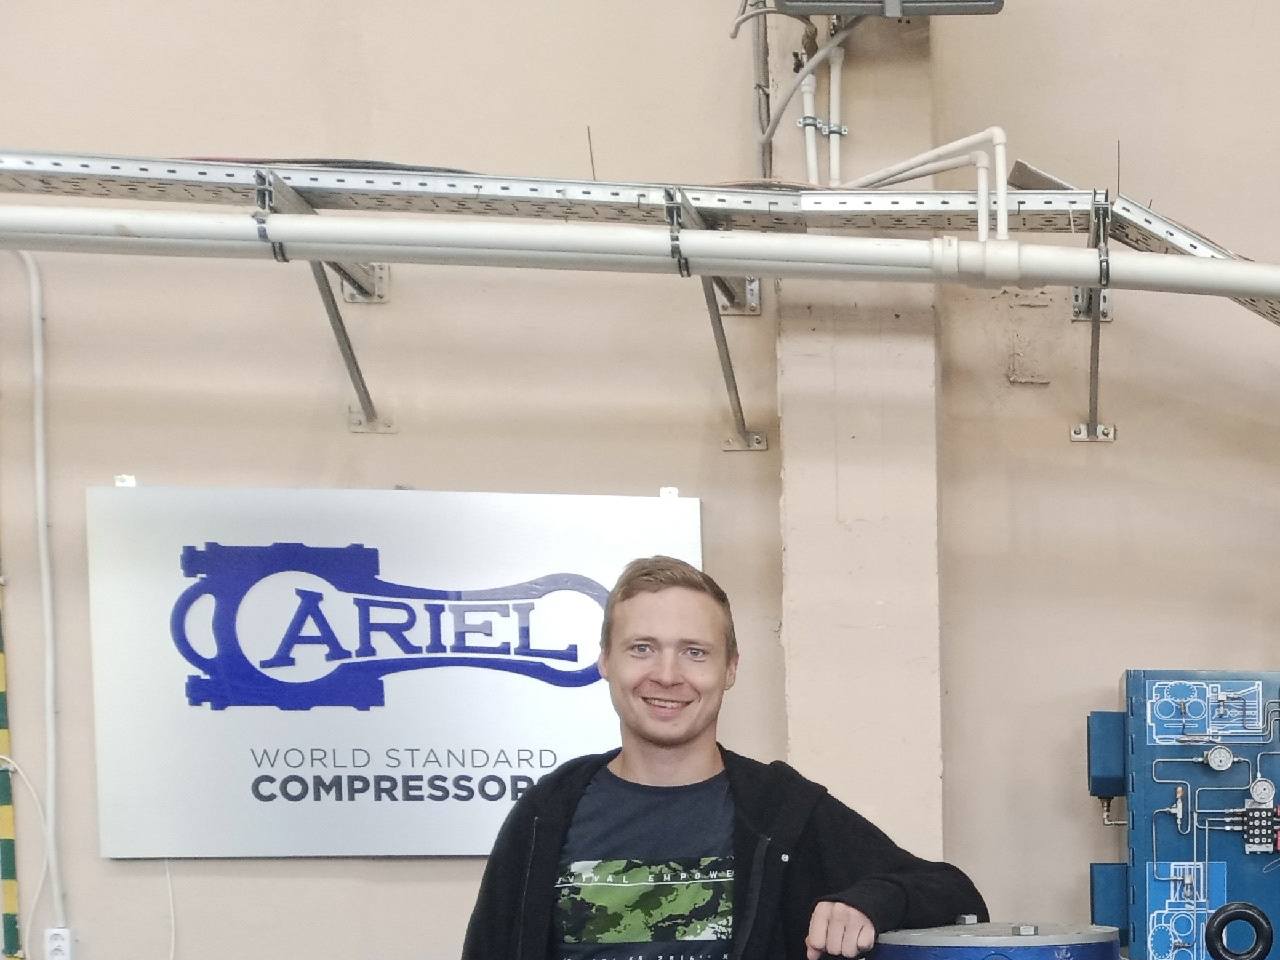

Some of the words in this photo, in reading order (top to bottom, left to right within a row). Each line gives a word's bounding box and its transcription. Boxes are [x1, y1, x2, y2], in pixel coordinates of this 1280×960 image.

[260, 588, 577, 668] ARIEL
[250, 747, 371, 769] WORLD
[386, 747, 557, 769] STANDARD
[251, 774, 545, 802] COMPRESSOR
